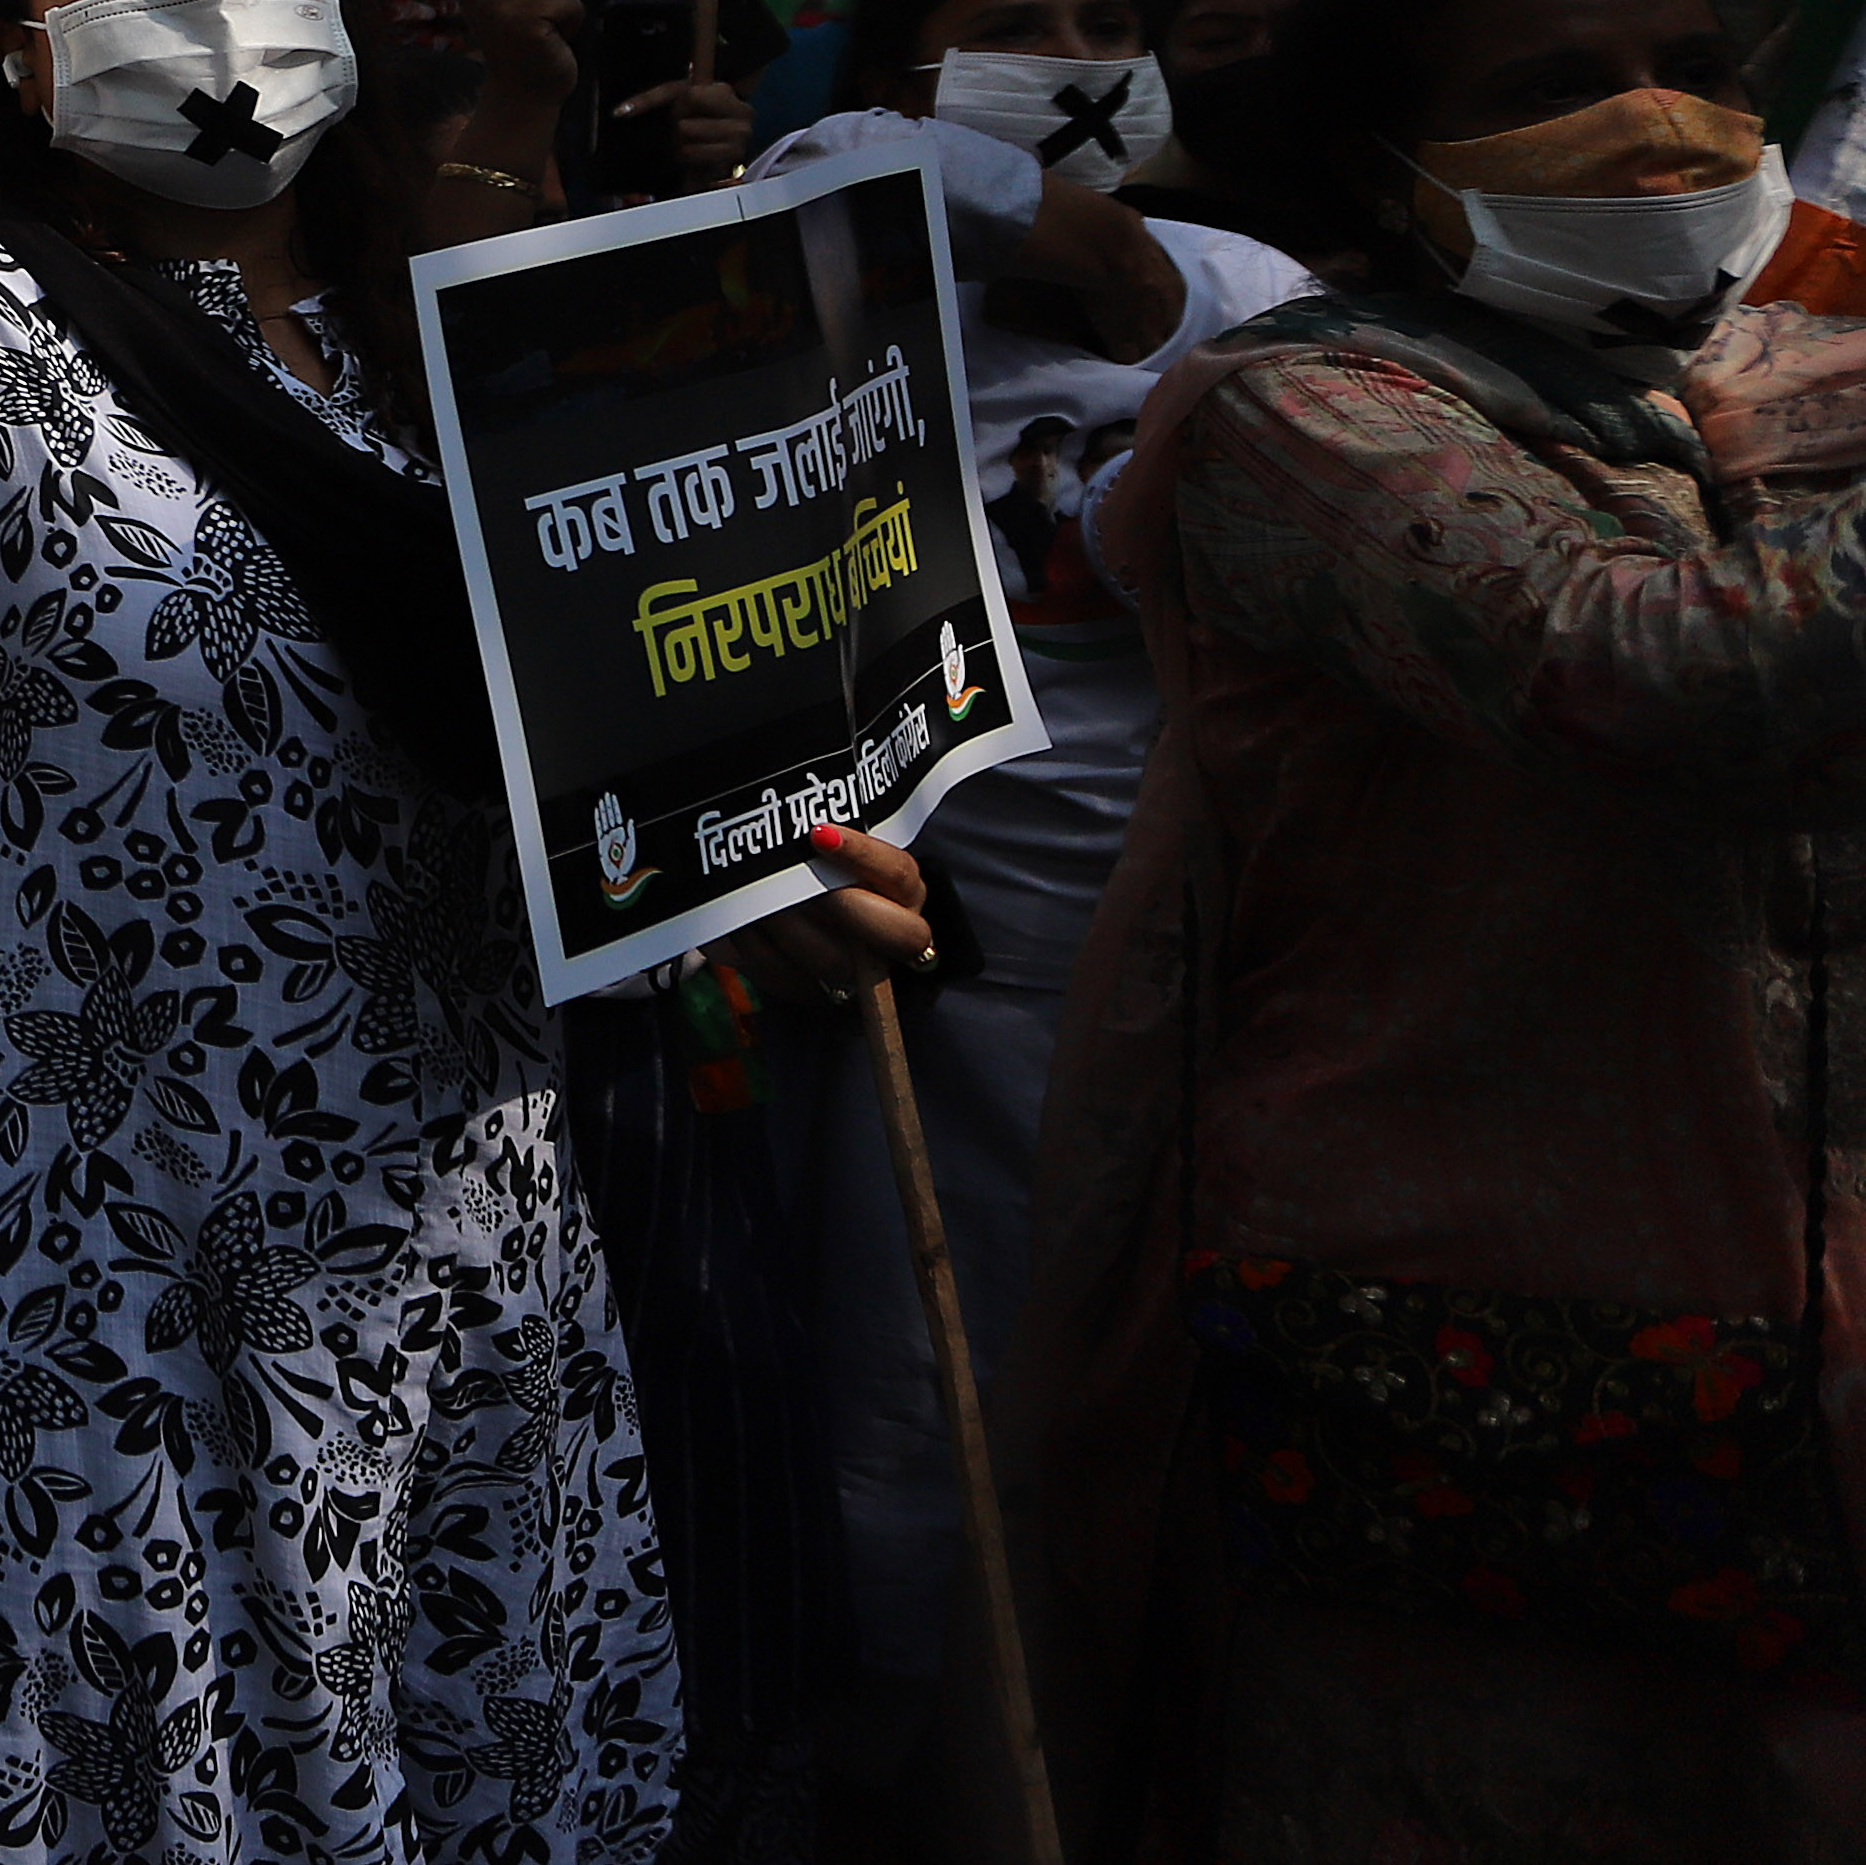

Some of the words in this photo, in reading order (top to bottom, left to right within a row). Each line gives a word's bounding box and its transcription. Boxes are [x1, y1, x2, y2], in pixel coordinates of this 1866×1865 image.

[524, 471, 638, 572] कब
[635, 442, 736, 545] तक
[735, 376, 847, 509] जलाई
[633, 549, 848, 701] निरपराध
[693, 787, 782, 877] दिल्ली
[785, 772, 860, 839] प्रदेश
[891, 702, 930, 769] कांग्रेस
